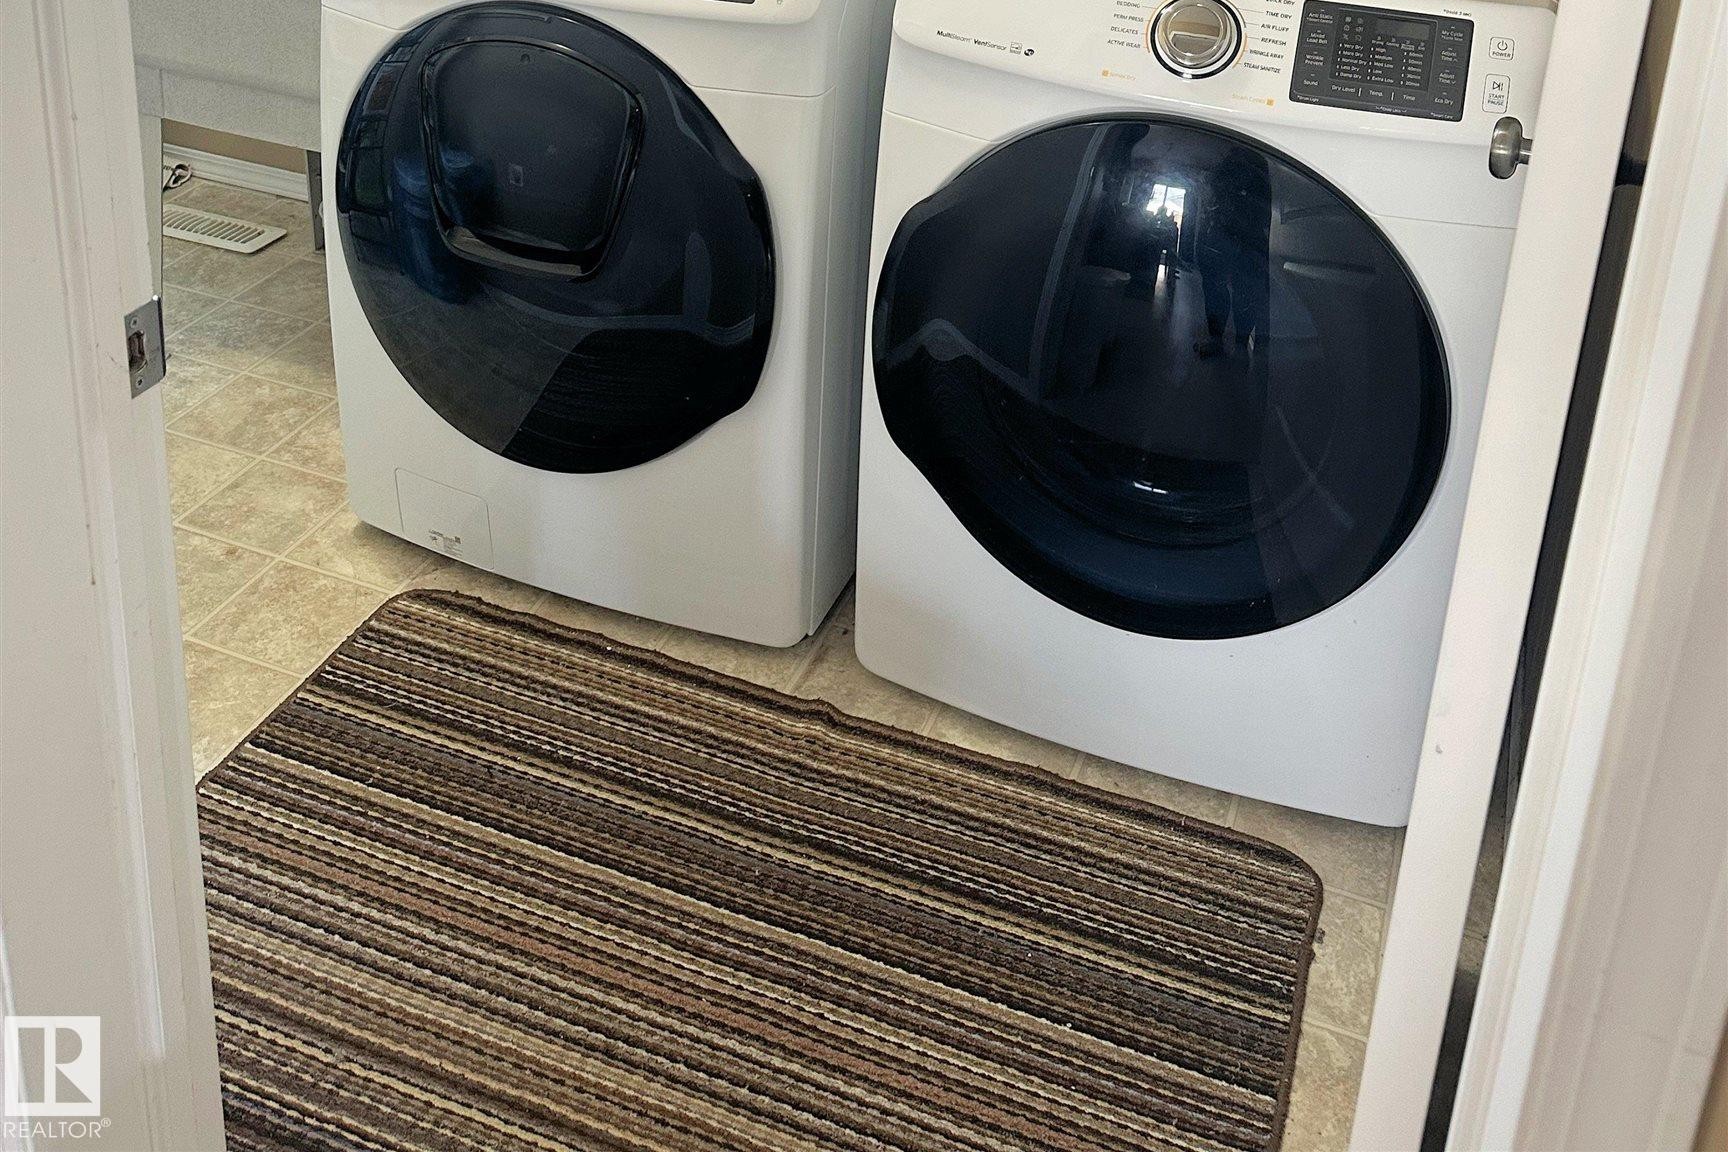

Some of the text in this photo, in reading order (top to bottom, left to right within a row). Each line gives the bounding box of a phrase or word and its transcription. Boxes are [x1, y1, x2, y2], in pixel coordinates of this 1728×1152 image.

[1116, 0, 1140, 8] BEDDING
[1110, 26, 1138, 35] DELICATES
[1107, 39, 1125, 47] ACTIVE
[1260, 37, 1287, 46] REFRESH
[1249, 48, 1270, 57] WRINKLE
[1260, 64, 1280, 73] SANITIZE
